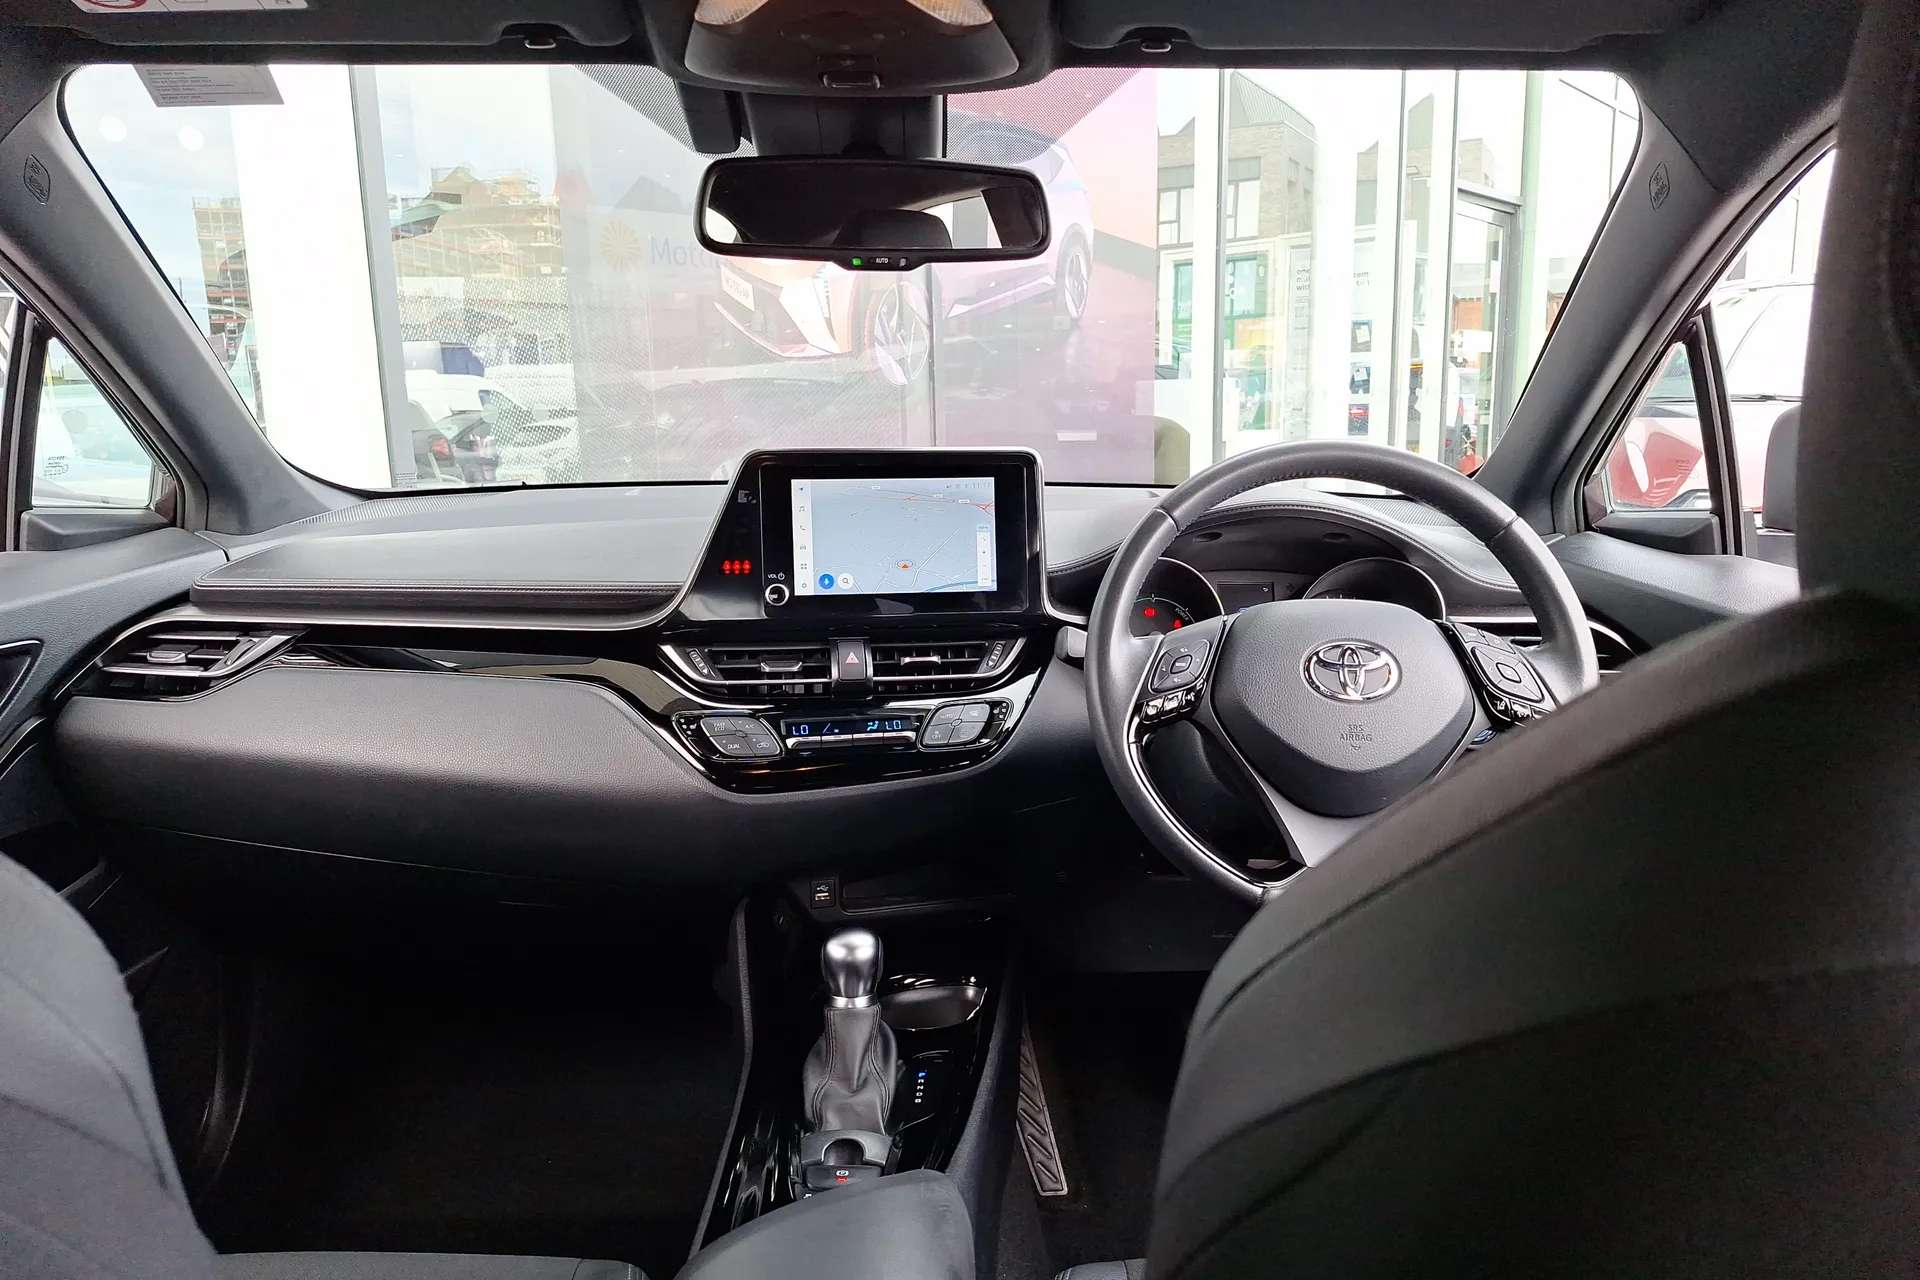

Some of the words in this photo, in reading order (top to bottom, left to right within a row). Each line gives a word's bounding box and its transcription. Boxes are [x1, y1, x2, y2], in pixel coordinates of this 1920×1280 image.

[792, 724, 809, 735] LO
[885, 720, 901, 730] LO
[1340, 733, 1372, 742] AIRBAG
